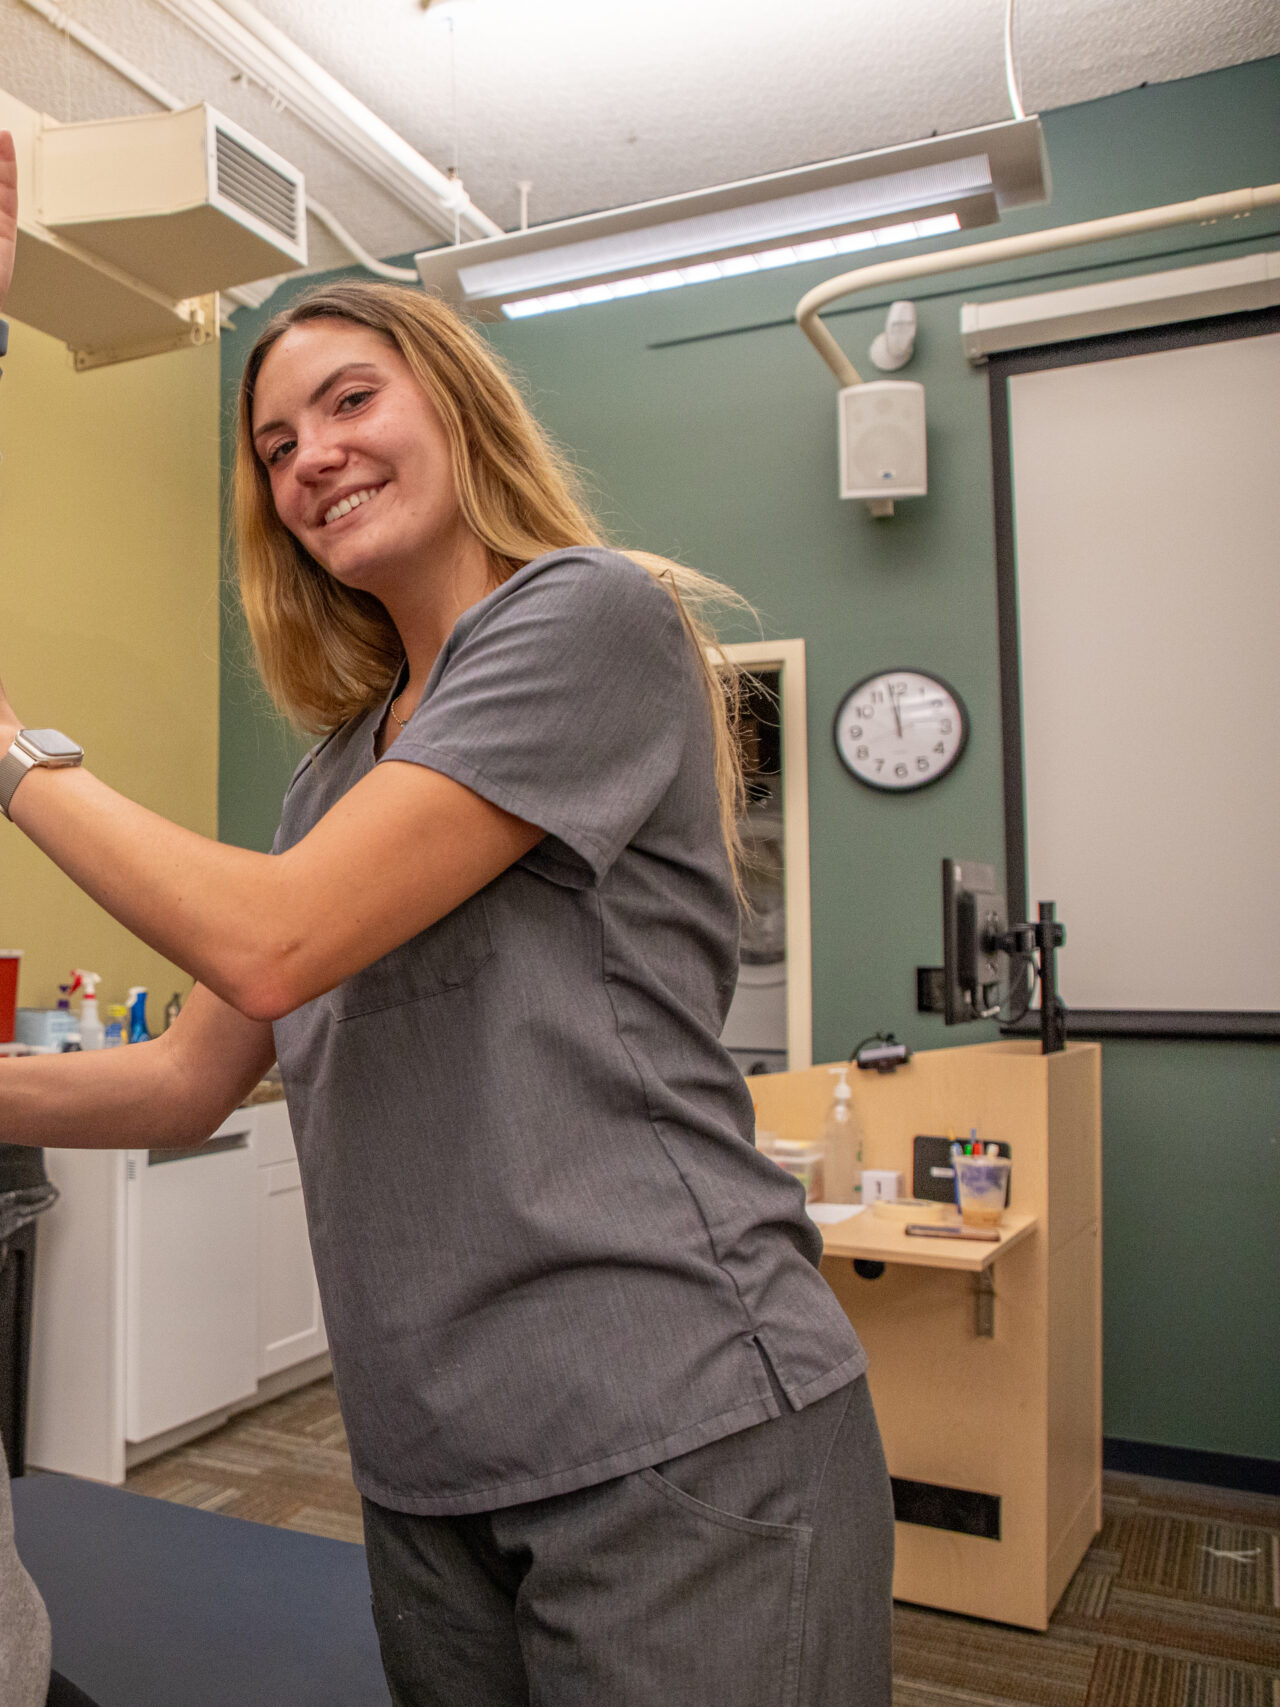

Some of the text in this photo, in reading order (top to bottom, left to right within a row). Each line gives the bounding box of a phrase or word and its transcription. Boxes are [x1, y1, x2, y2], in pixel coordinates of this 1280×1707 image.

[871, 690, 884, 704] 11
[855, 704, 874, 719] 10
[850, 724, 863, 740] 9
[940, 718, 952, 735] 3
[856, 744, 869, 760] 8
[933, 740, 945, 755] 4
[874, 758, 885, 773] 7
[894, 762, 908, 778] 6
[916, 755, 930, 772] 5
